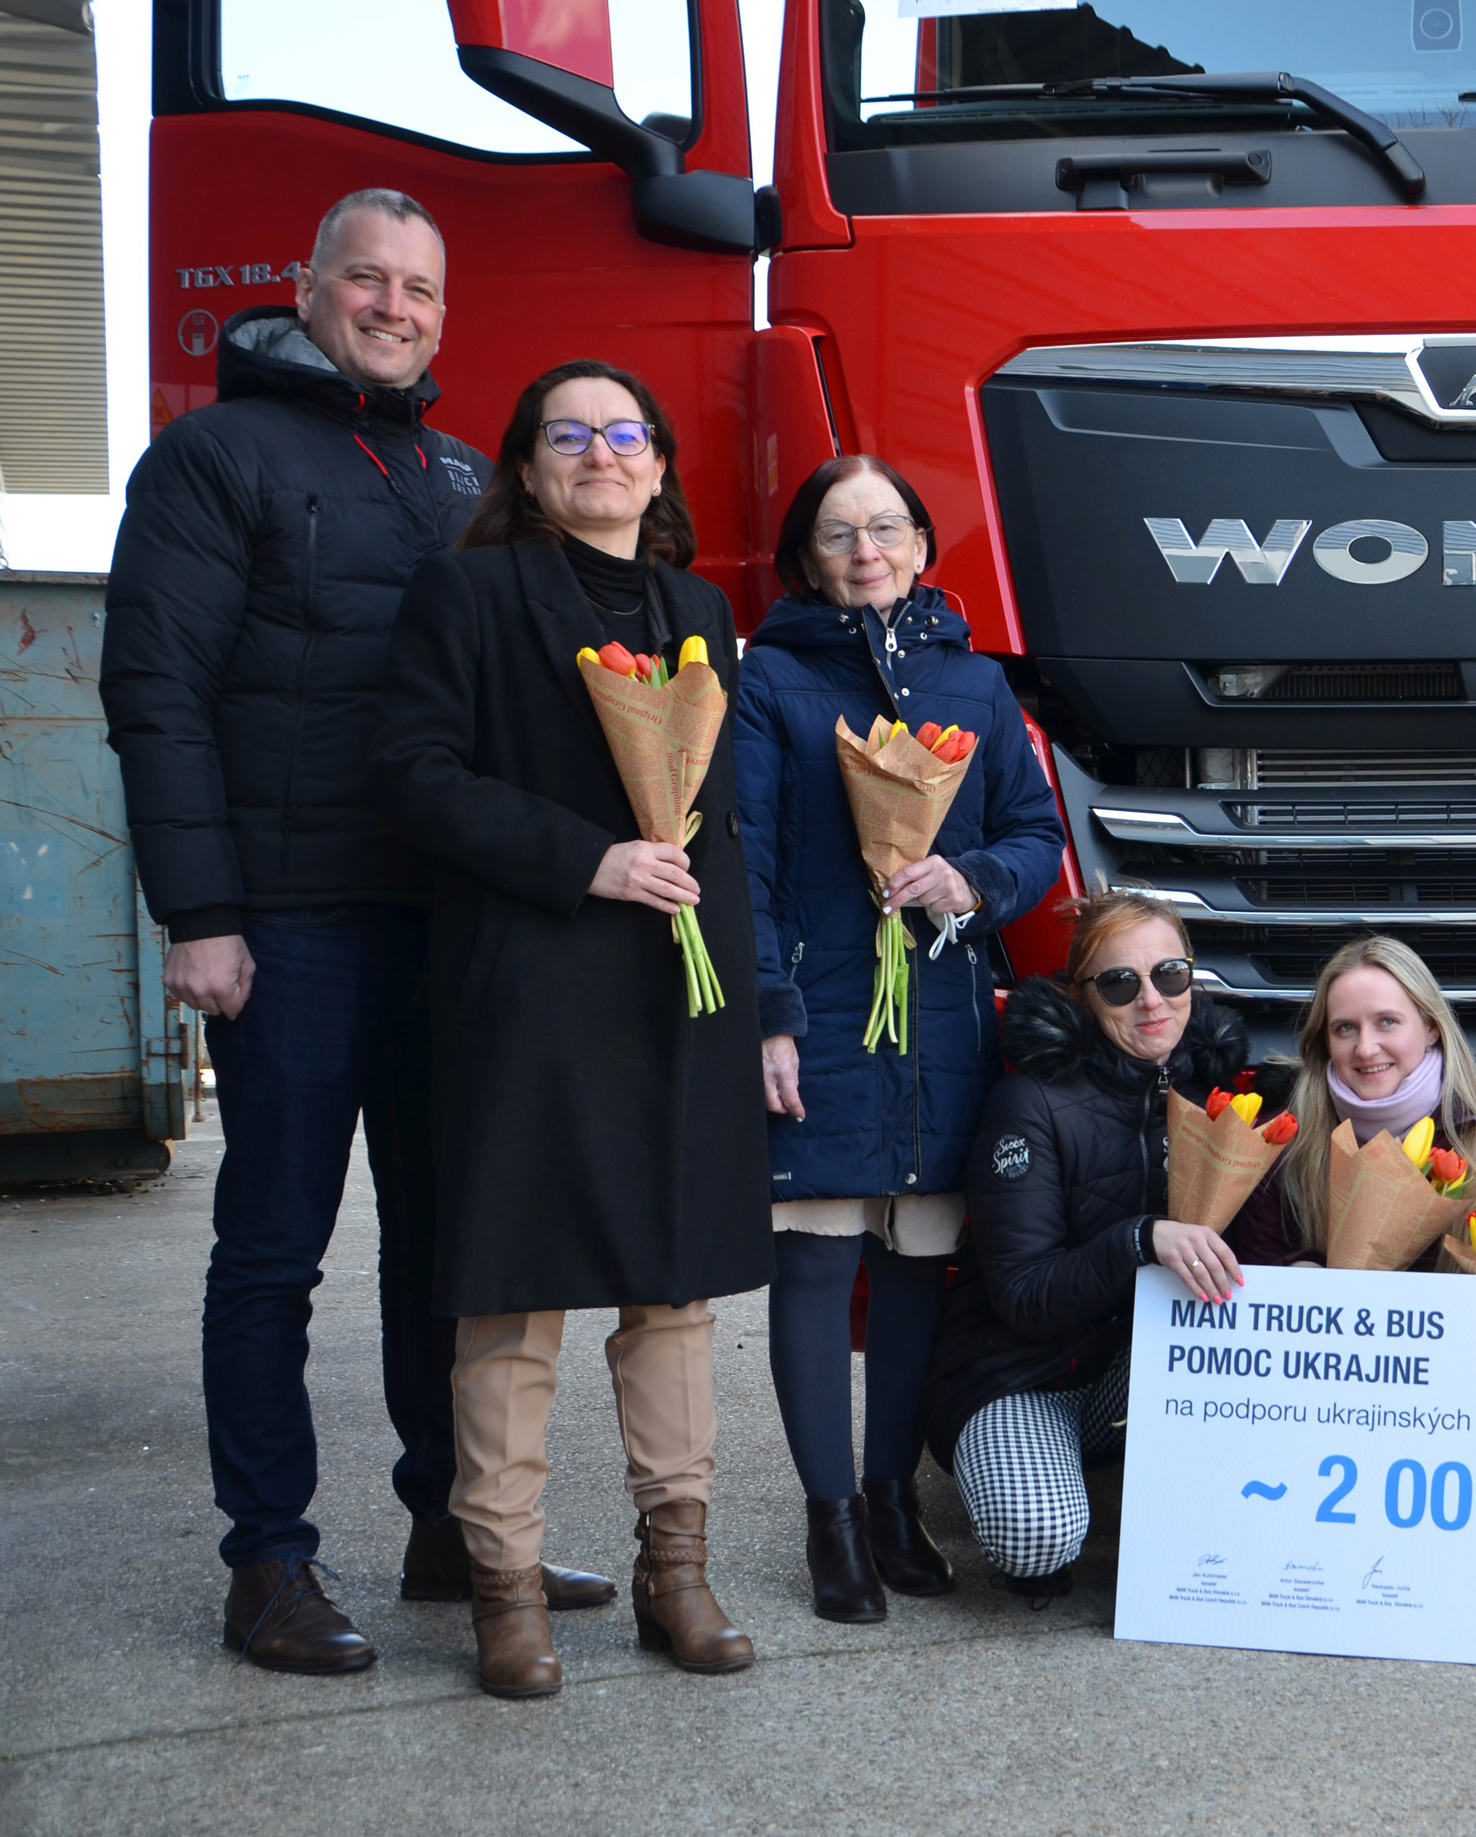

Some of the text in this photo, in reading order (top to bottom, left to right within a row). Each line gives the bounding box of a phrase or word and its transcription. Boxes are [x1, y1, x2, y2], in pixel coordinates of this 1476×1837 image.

[175, 265, 235, 289] TGX
[439, 456, 472, 471] MAN
[627, 705, 662, 726] Original
[993, 1147, 1030, 1174] Spirit
[1170, 1299, 1445, 1340] MAN TRUCK & BUS
[1168, 1345, 1430, 1386] POMOC UKRAJINE
[1165, 1398, 1194, 1417] na
[1203, 1398, 1307, 1427] podporu
[1316, 1402, 1471, 1435] ukrajinských
[1315, 1454, 1358, 1524] 2
